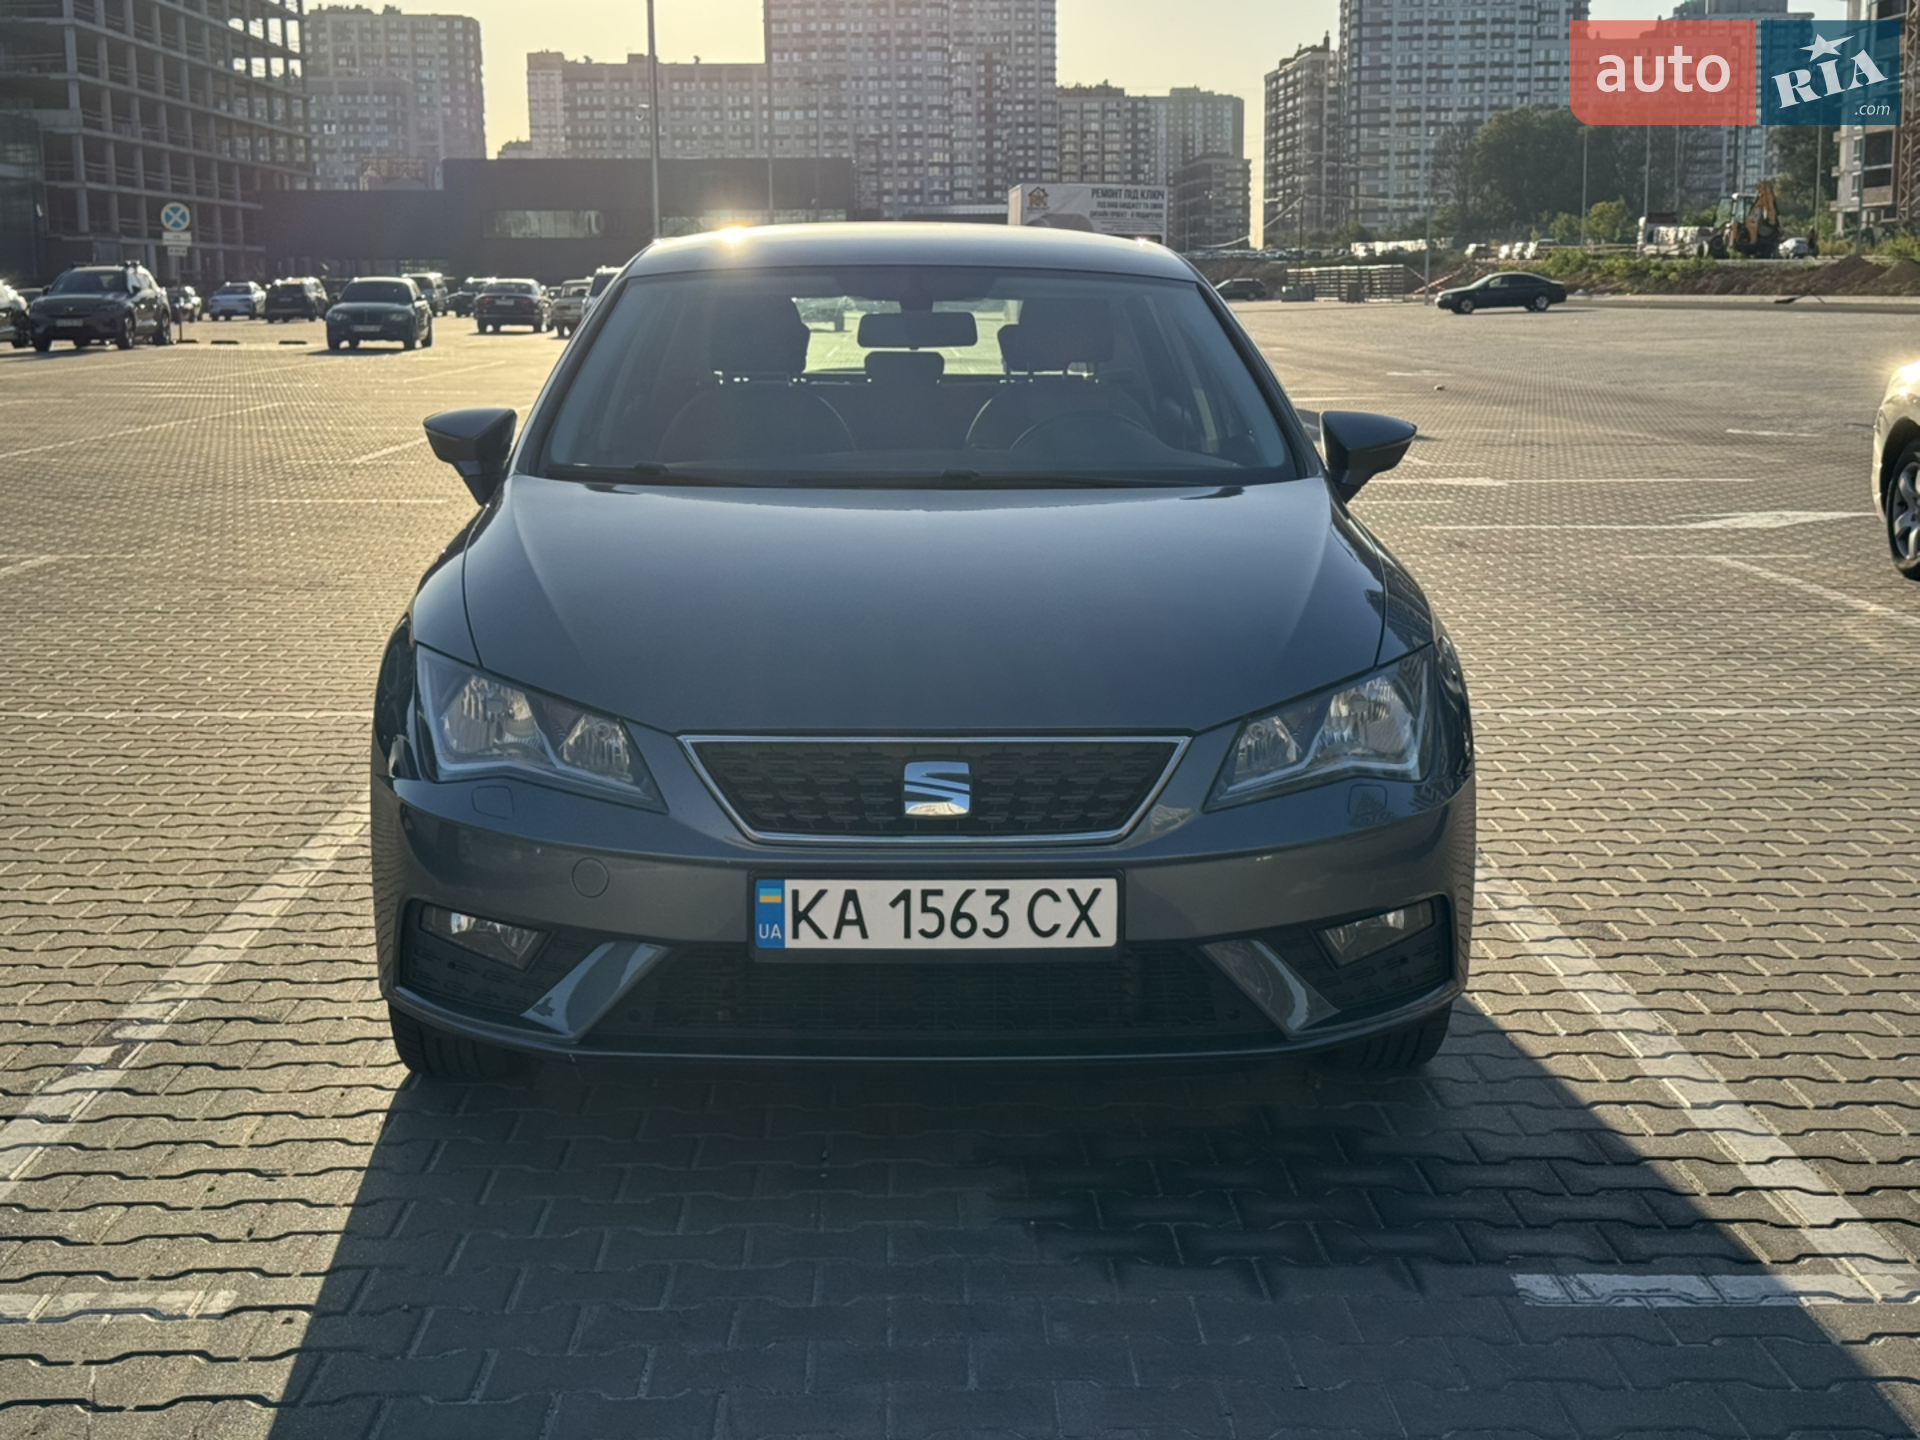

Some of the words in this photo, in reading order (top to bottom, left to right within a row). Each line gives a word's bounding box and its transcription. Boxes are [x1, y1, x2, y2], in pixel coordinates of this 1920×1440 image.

[1091, 187, 1123, 199] РЕМОНТ
[1124, 188, 1139, 200] ПІД
[1140, 188, 1165, 200] КЛЮЧ
[791, 888, 869, 940] KA
[888, 888, 1010, 940] 1563
[1027, 887, 1102, 939] CX
[758, 924, 782, 939] UA
